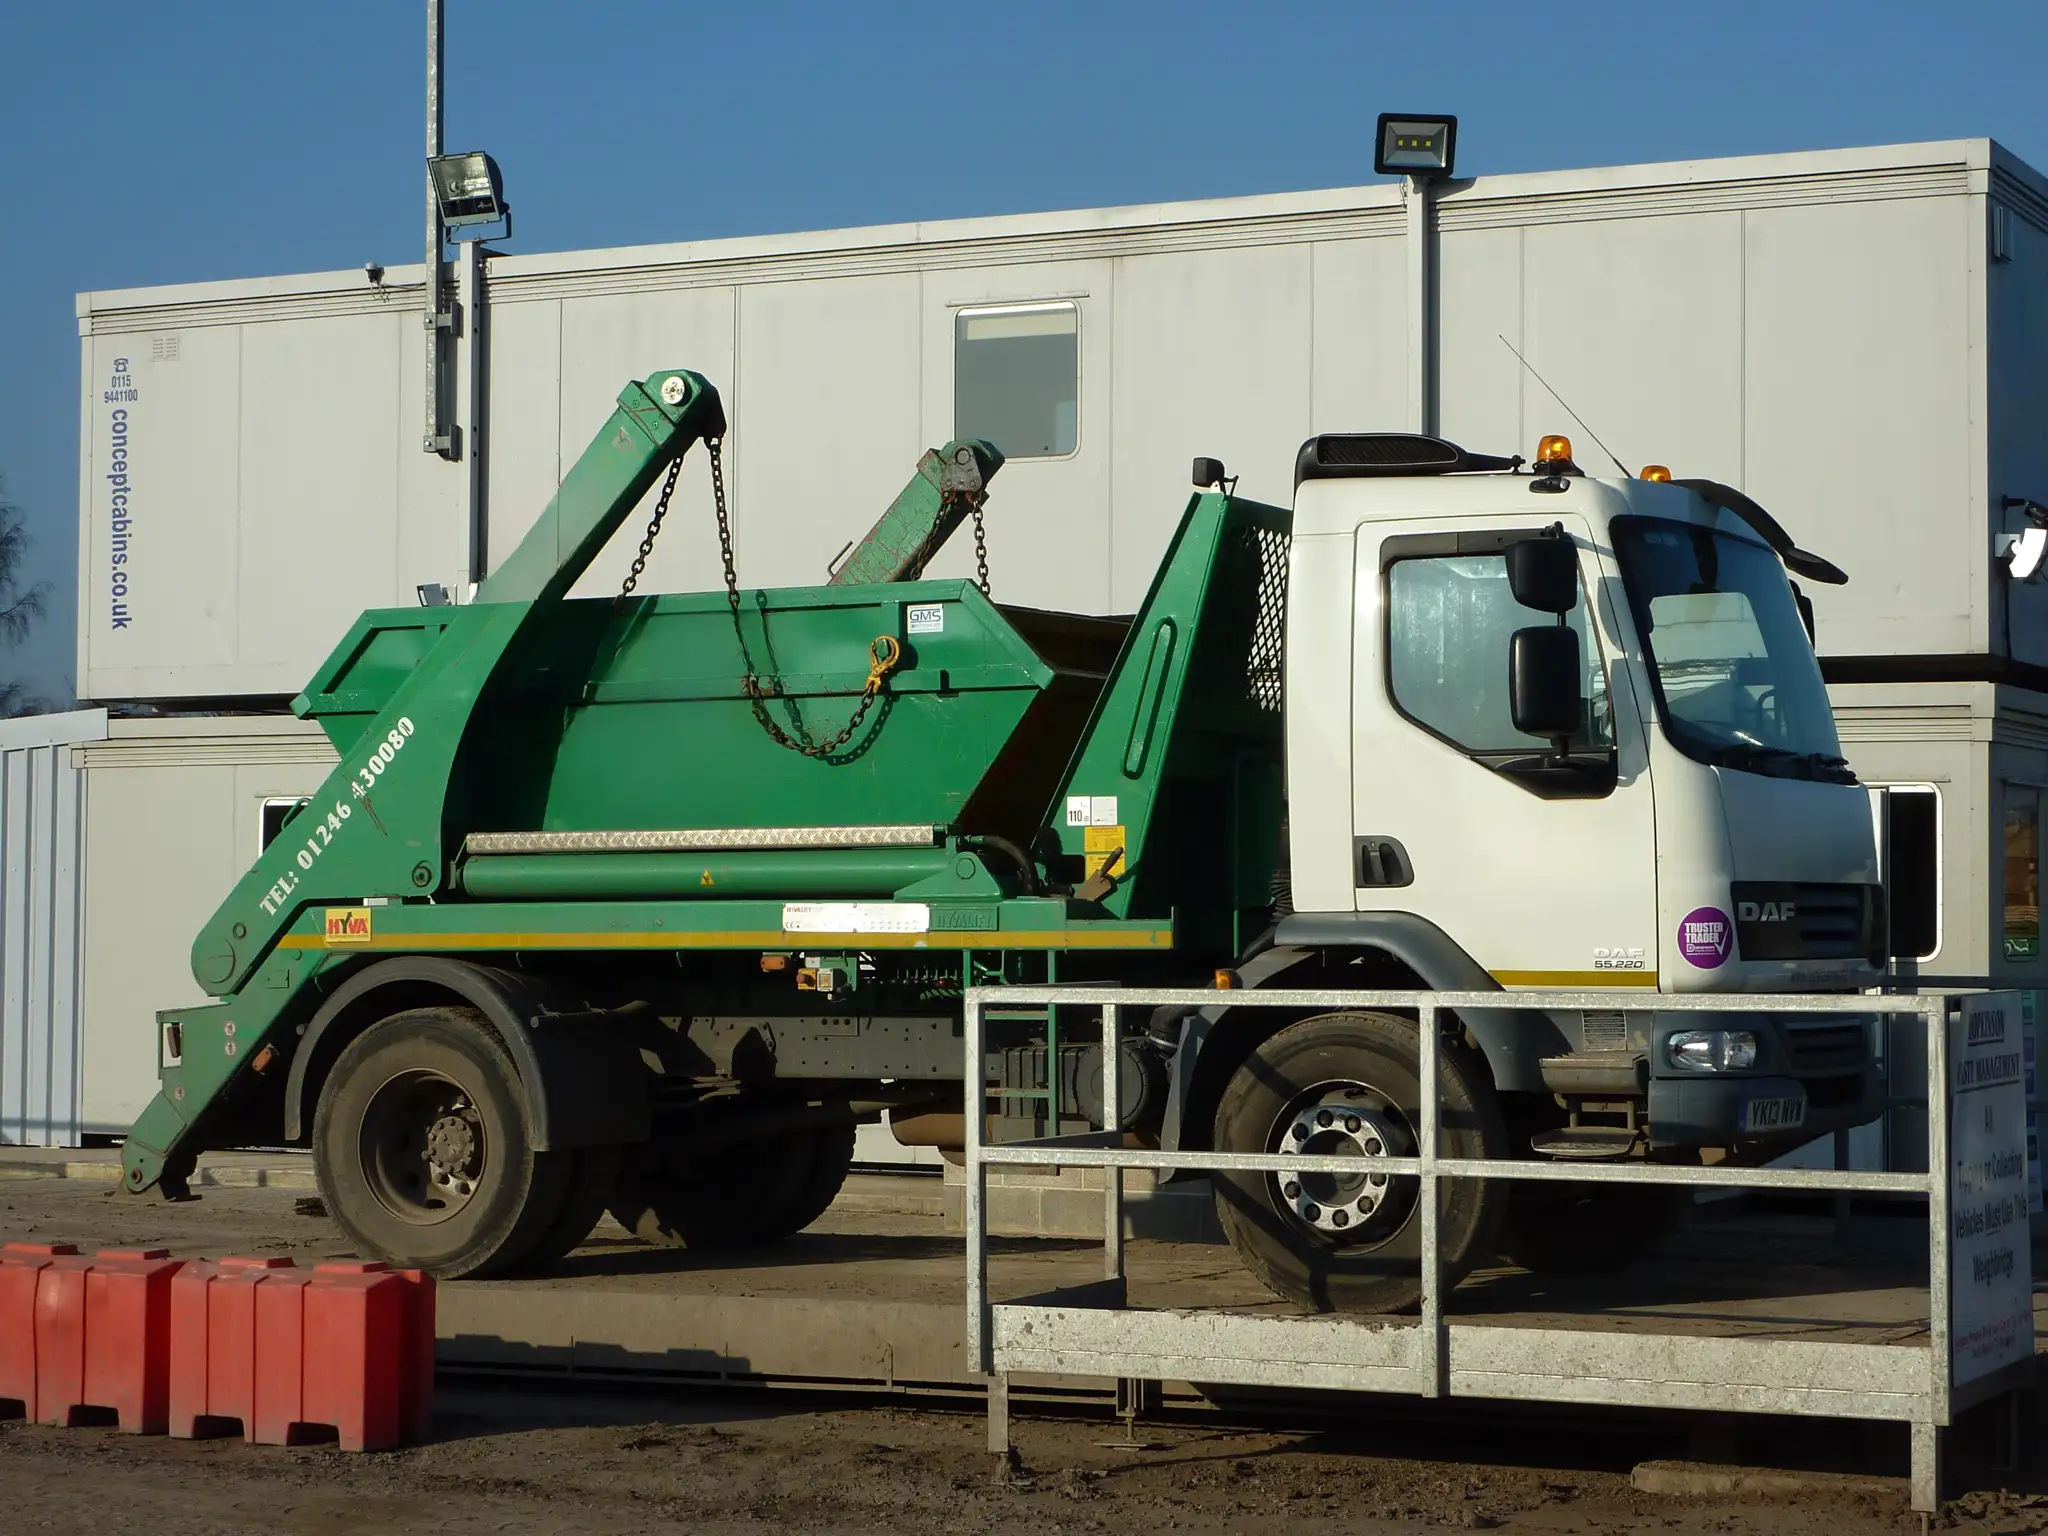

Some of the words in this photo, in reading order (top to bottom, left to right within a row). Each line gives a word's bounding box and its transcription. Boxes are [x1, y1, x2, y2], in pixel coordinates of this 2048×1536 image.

[111, 375, 132, 388] 0115
[104, 389, 138, 403] 9441100
[106, 408, 133, 630] conceptcabins.co.uk
[909, 609, 942, 622] GMS
[1069, 810, 1083, 822] 110
[259, 870, 300, 916] TEL:
[296, 799, 352, 870] 01246
[1738, 901, 1795, 921] DAF
[328, 911, 369, 934] HYVA
[1685, 922, 1724, 933] TRUSTED
[1685, 932, 1720, 944] TRADER
[1594, 947, 1645, 958] DAF
[1594, 960, 1644, 969] 55.220
[1976, 1053, 2019, 1081] MANAGEMENT
[1954, 1207, 1984, 1240] Vehicles
[1985, 1202, 2001, 1230] Must
[1973, 1245, 2014, 1286] Weighbridge
